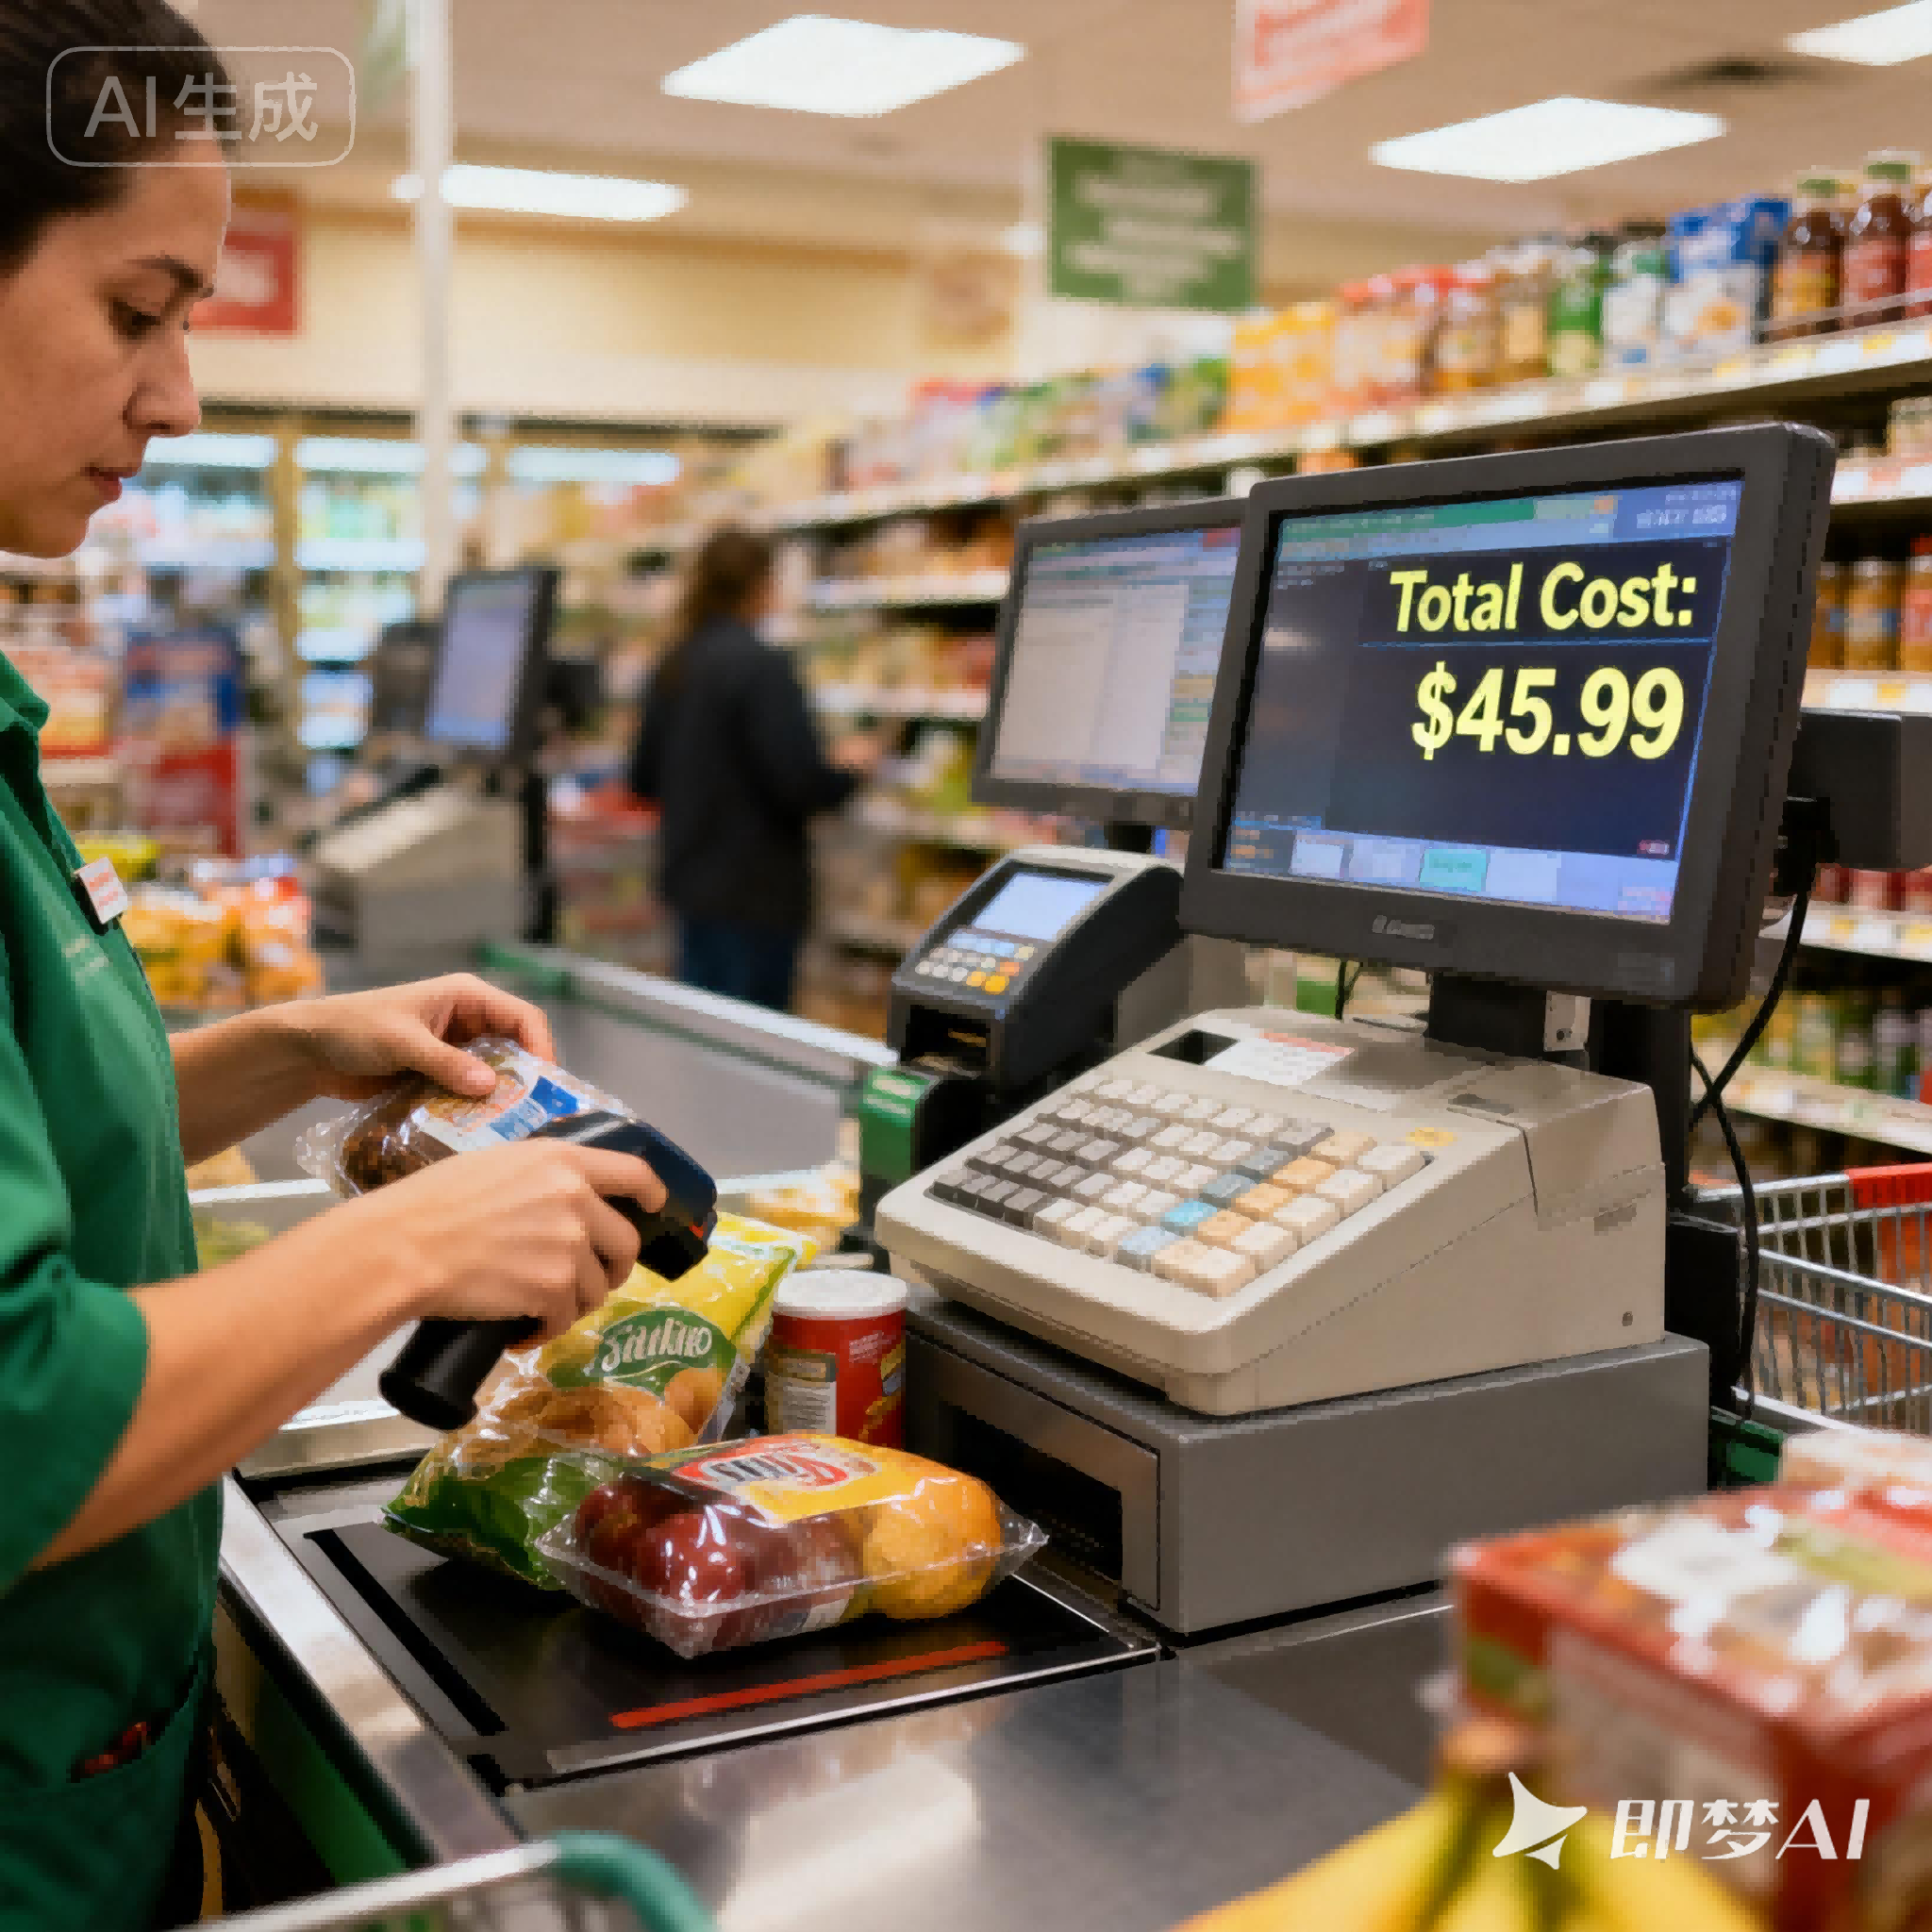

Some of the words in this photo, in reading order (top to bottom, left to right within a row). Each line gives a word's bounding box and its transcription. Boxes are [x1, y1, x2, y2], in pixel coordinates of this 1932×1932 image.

[1390, 562, 1524, 631] Total
[1541, 562, 1696, 630] Cost:
[1411, 660, 1684, 760] $45.99
